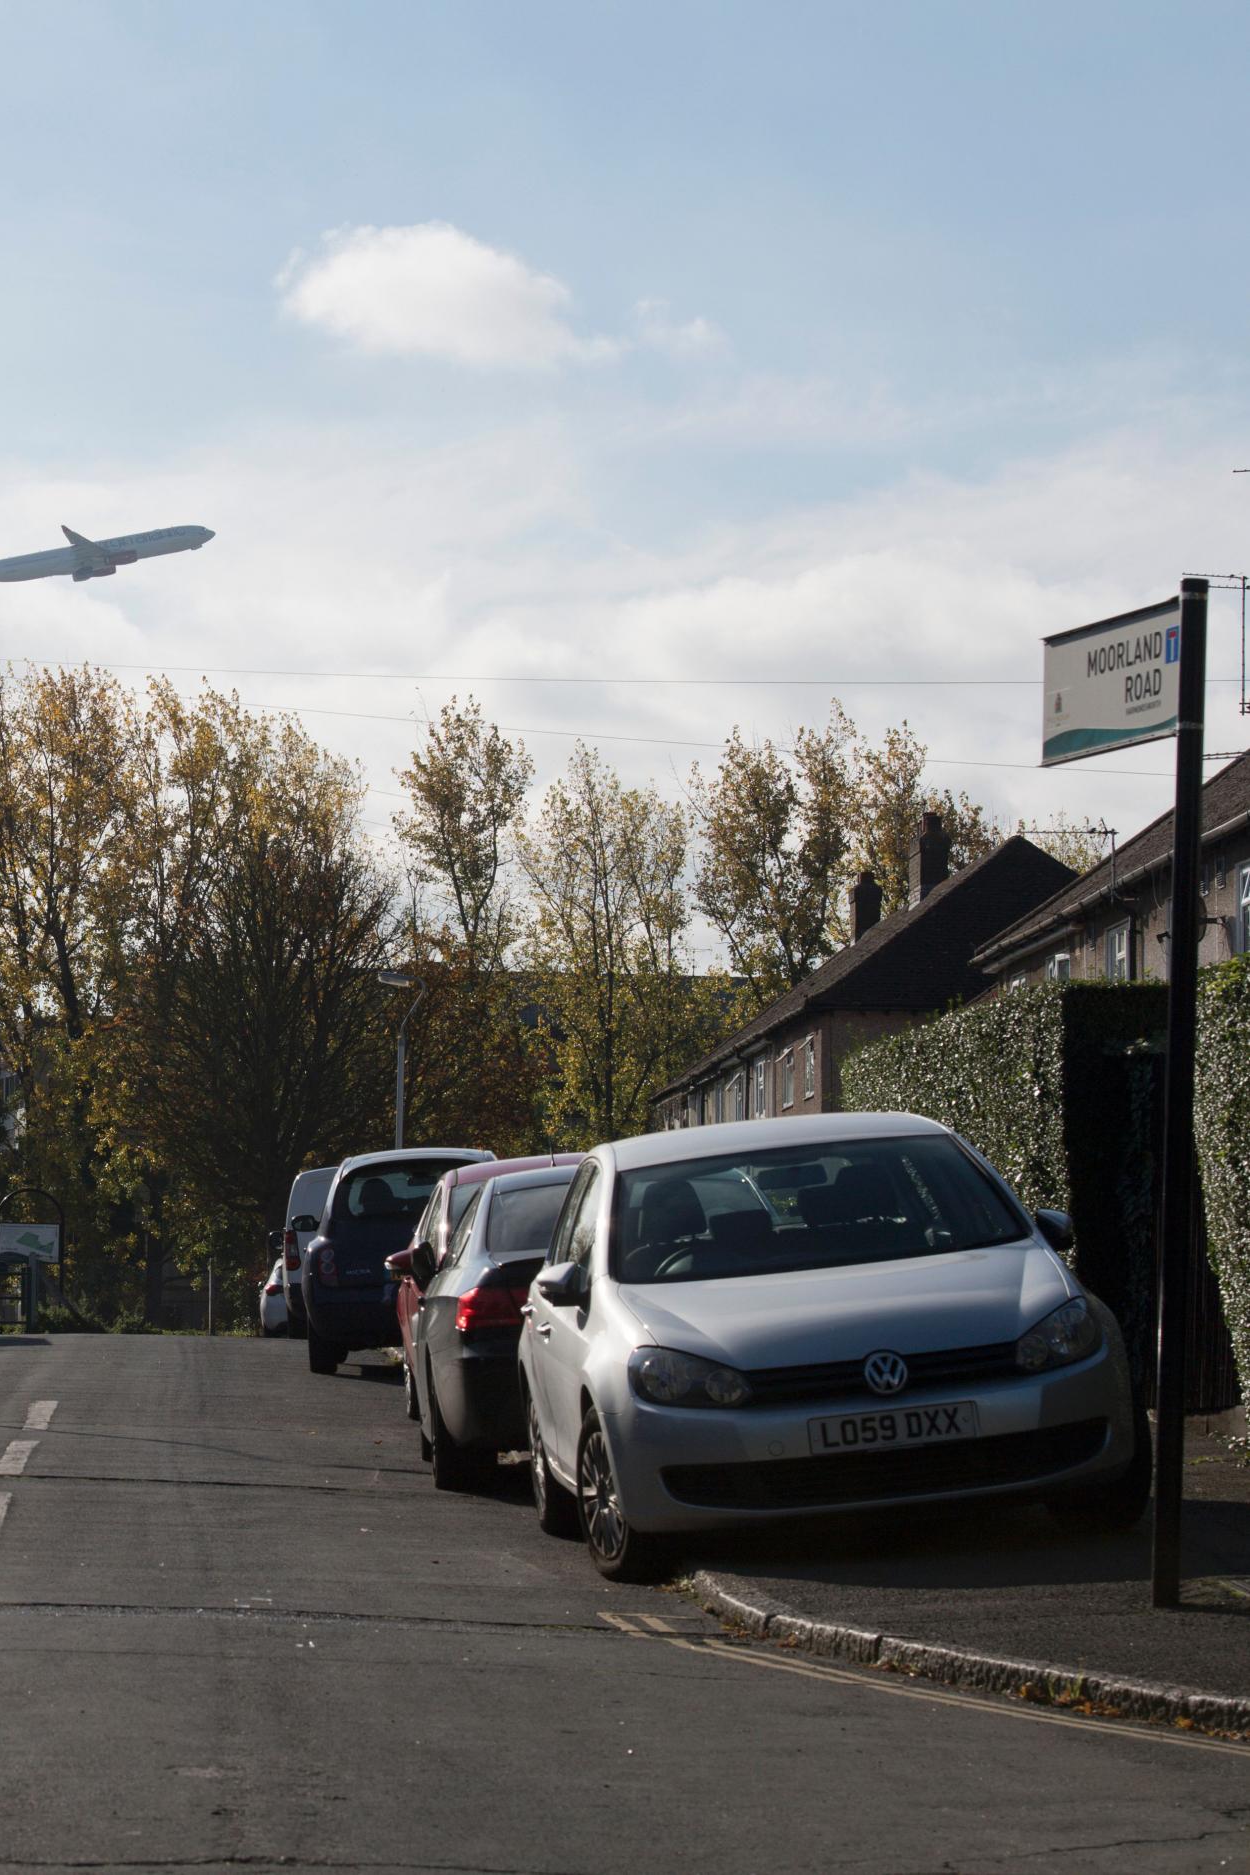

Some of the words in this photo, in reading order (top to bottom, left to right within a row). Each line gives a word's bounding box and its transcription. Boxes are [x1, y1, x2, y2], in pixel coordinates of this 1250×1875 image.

[1087, 631, 1163, 678] MOORLAND
[1125, 668, 1162, 703] ROAD
[904, 1406, 961, 1438] DXX
